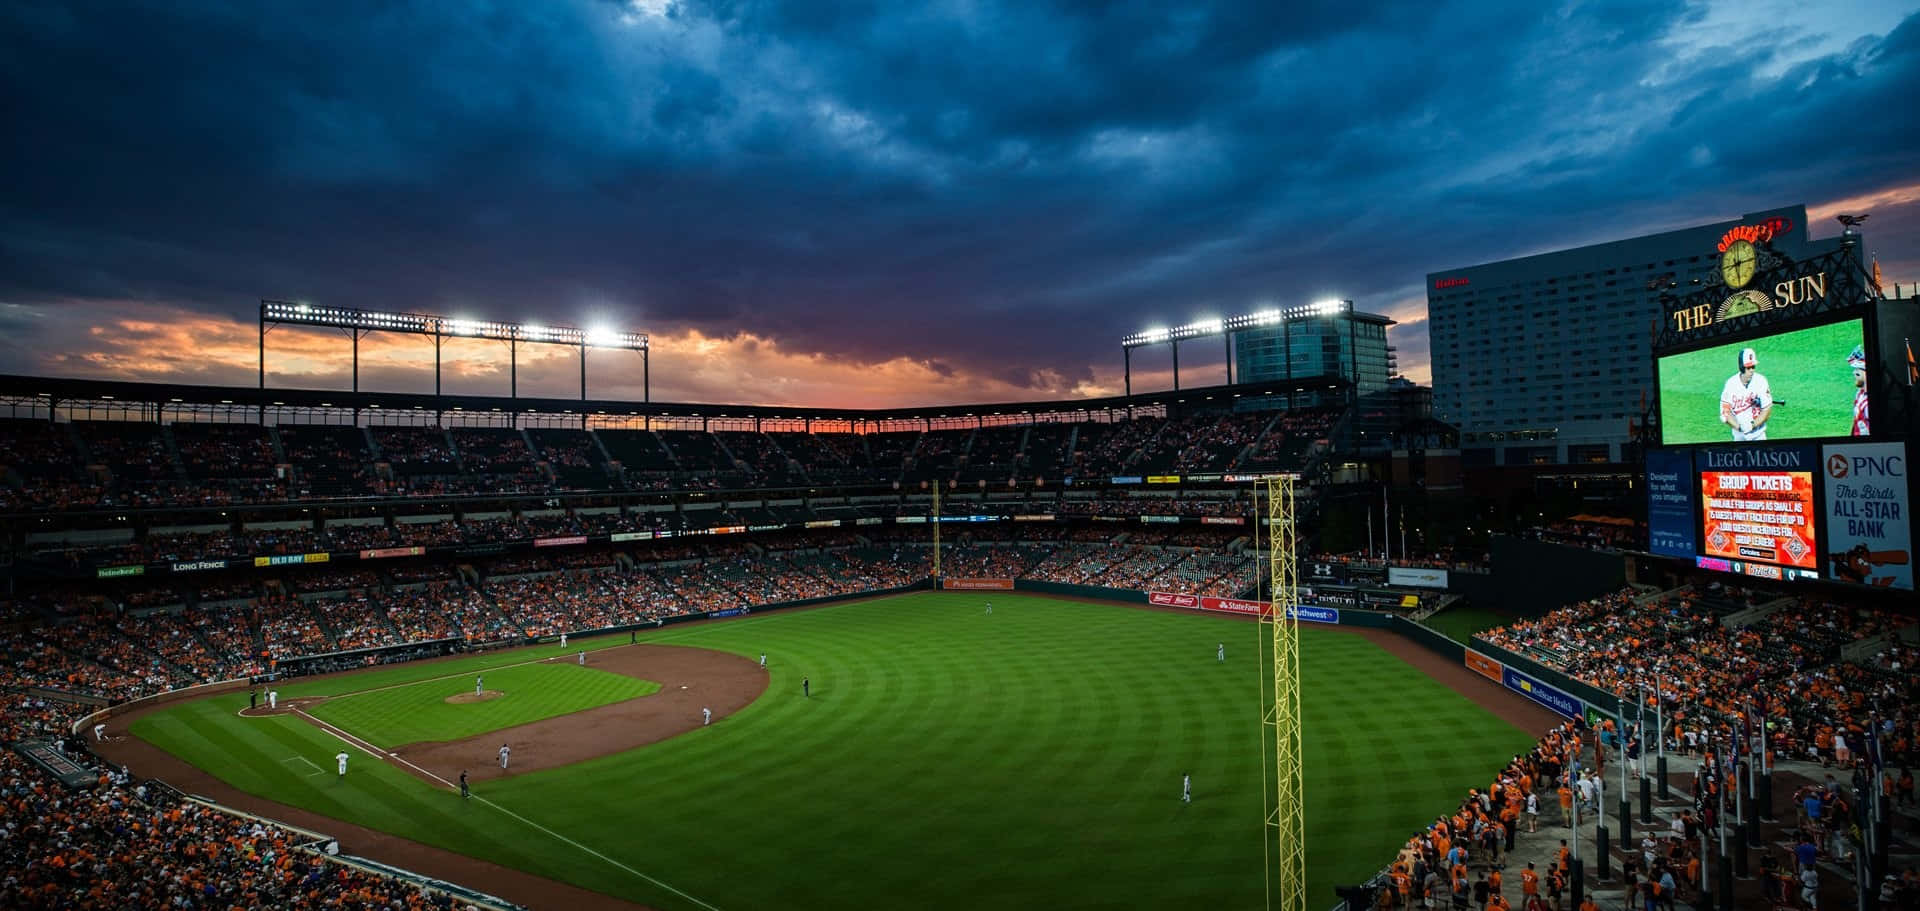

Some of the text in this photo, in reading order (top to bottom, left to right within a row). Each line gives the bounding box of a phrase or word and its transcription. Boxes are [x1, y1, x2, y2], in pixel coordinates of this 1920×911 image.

[1673, 272, 1826, 332] THE SUN
[1708, 450, 1800, 468] LEGG MASON
[1852, 456, 1902, 477] PNC
[1719, 475, 1792, 491] GROUP TICKETS
[1835, 484, 1896, 499] The Birds
[1834, 501, 1901, 520] ALL-STAR
[1848, 520, 1885, 539] BANK
[173, 561, 225, 572] LONG FENCE
[272, 556, 287, 565] OLD
